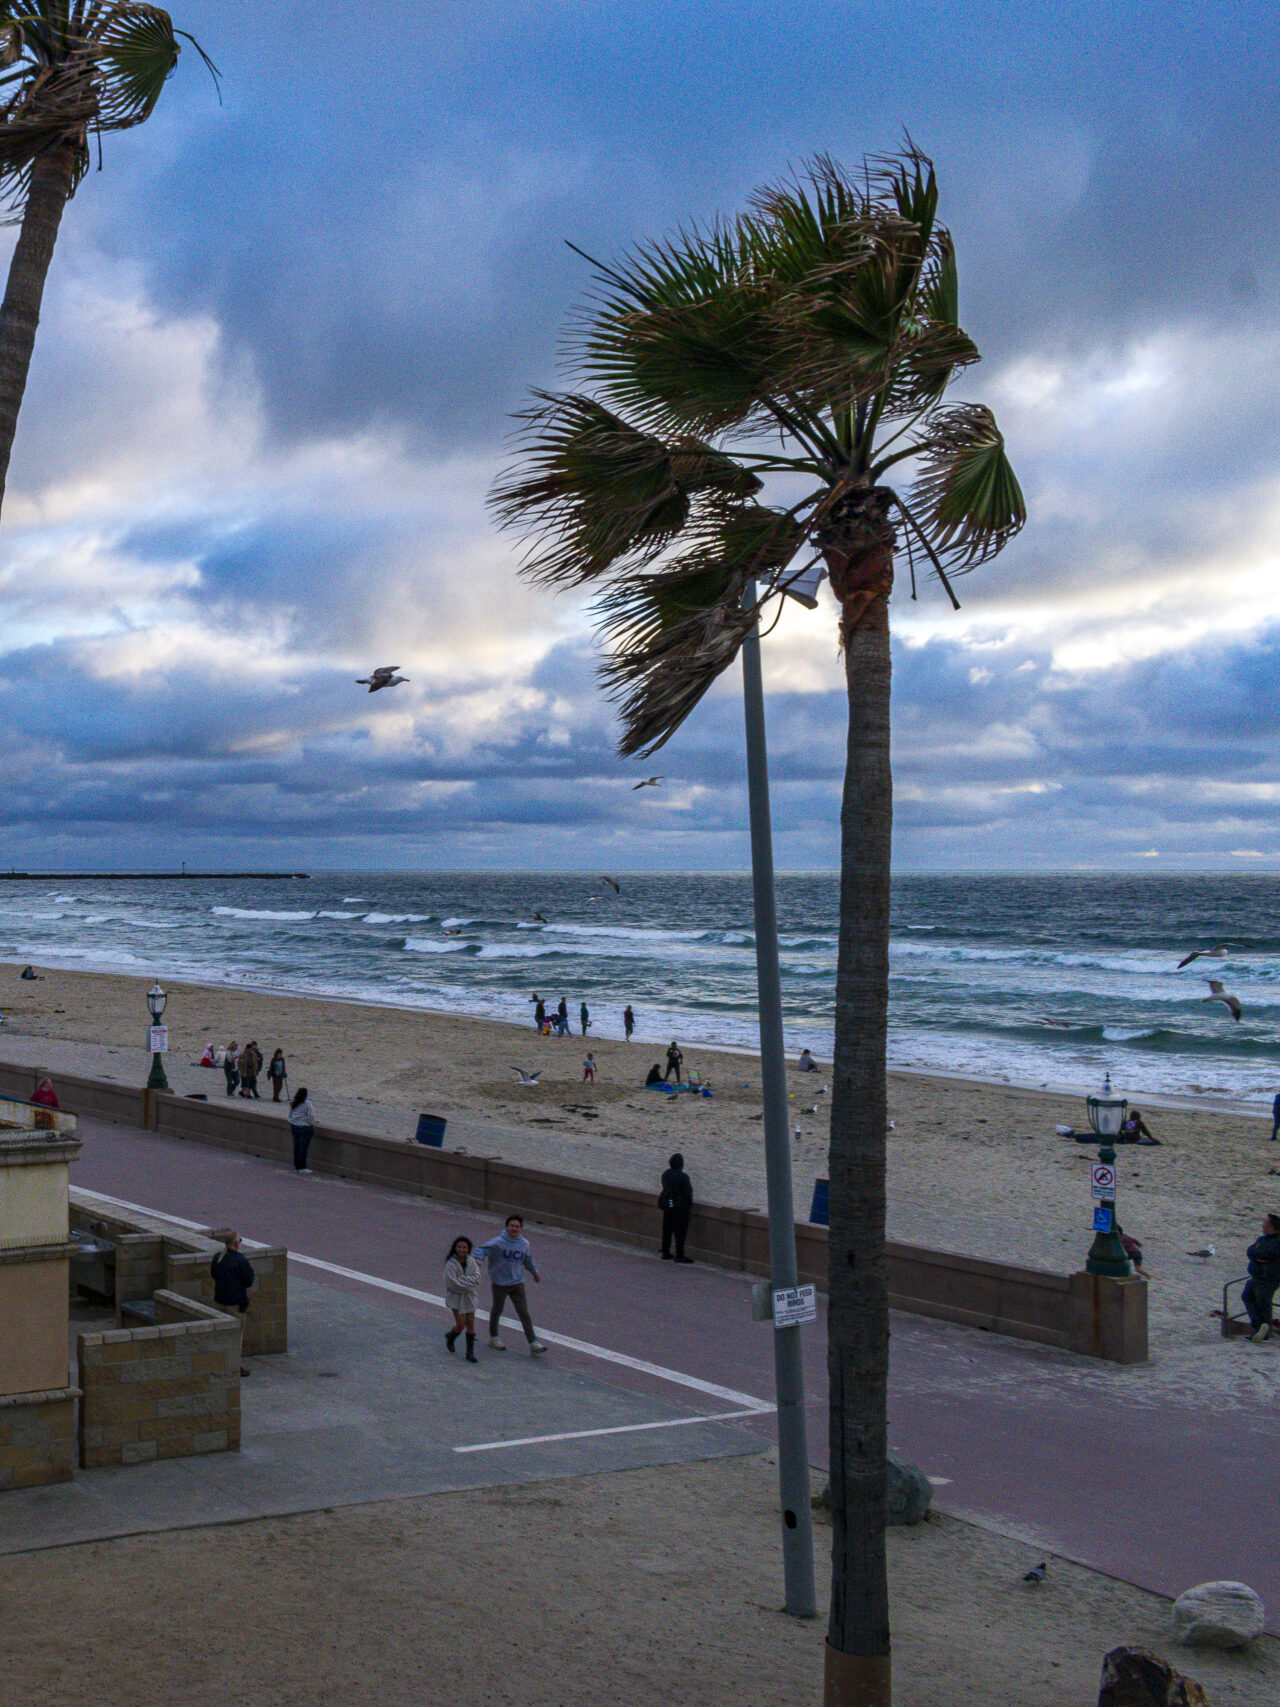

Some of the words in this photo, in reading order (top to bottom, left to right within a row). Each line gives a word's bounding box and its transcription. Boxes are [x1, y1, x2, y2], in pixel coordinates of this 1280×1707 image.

[503, 1249, 524, 1260] UCI
[776, 1294, 785, 1302] DO
[786, 1291, 798, 1299] NOT
[799, 1288, 812, 1297] FEED
[787, 1298, 805, 1307] BIRDS
